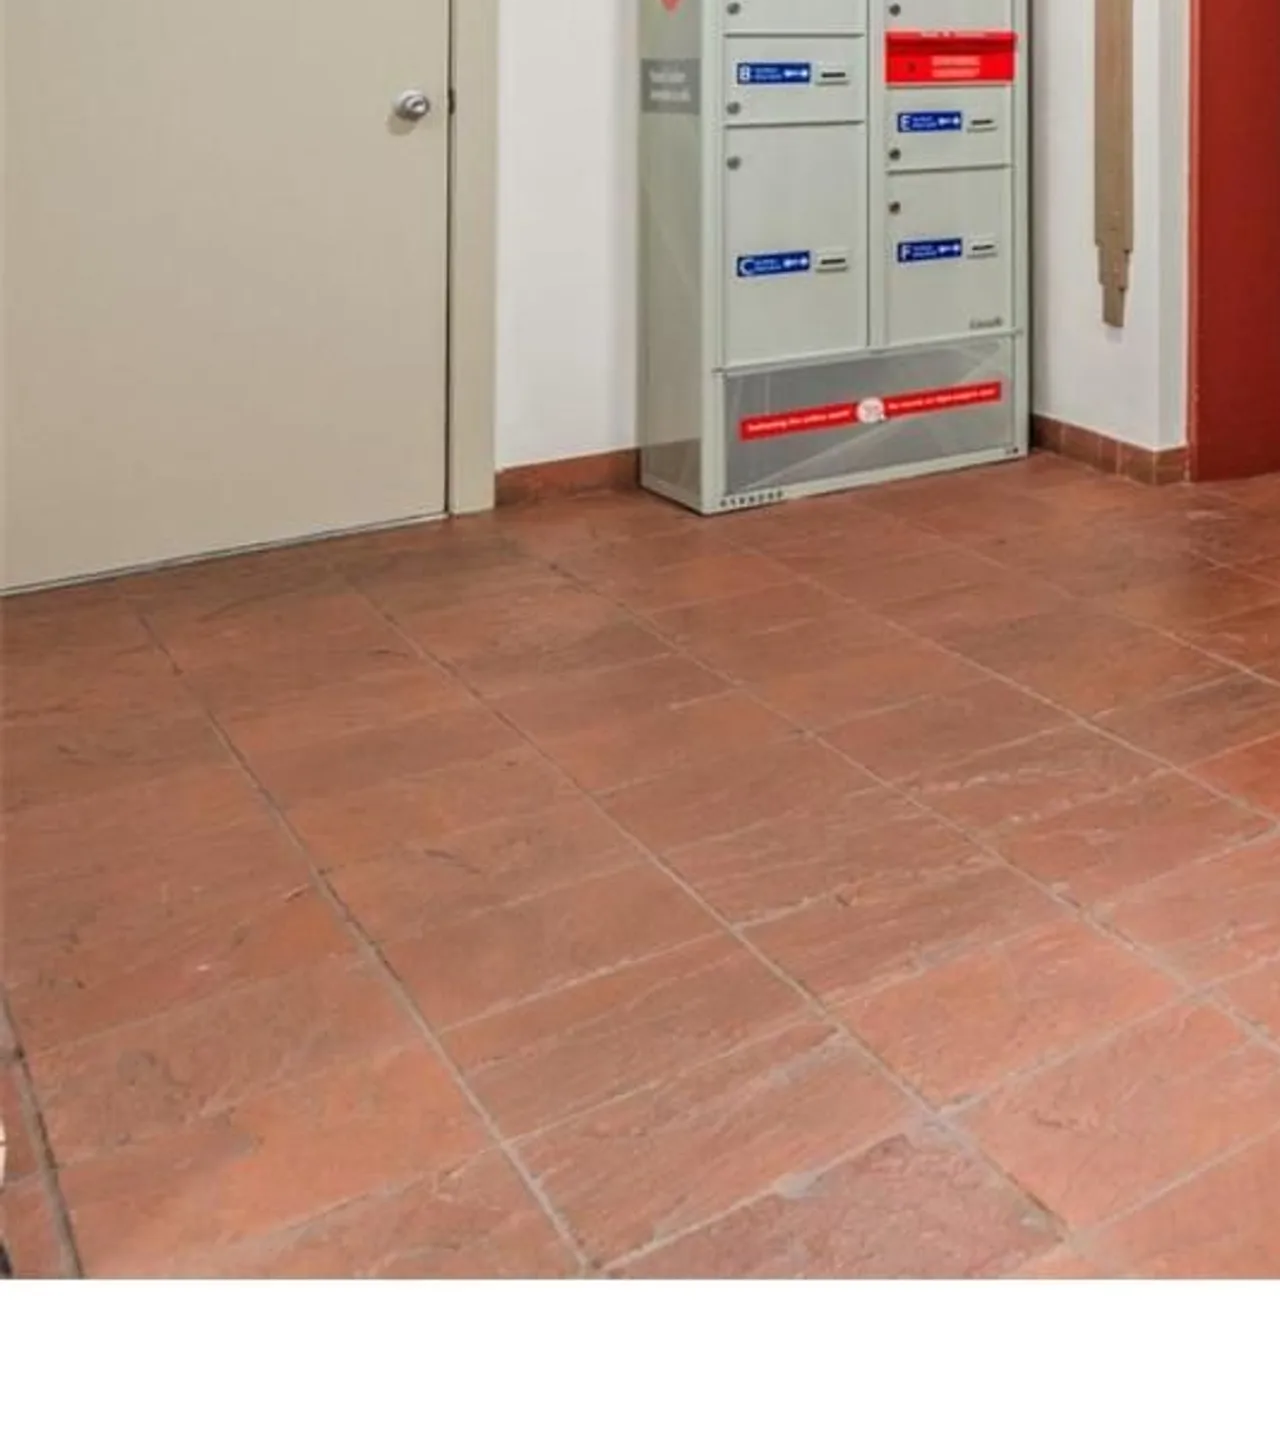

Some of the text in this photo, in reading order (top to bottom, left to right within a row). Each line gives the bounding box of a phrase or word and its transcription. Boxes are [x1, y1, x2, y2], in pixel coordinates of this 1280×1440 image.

[739, 65, 751, 81] B
[900, 115, 911, 131] E
[901, 244, 912, 260] F
[740, 259, 756, 276] C
